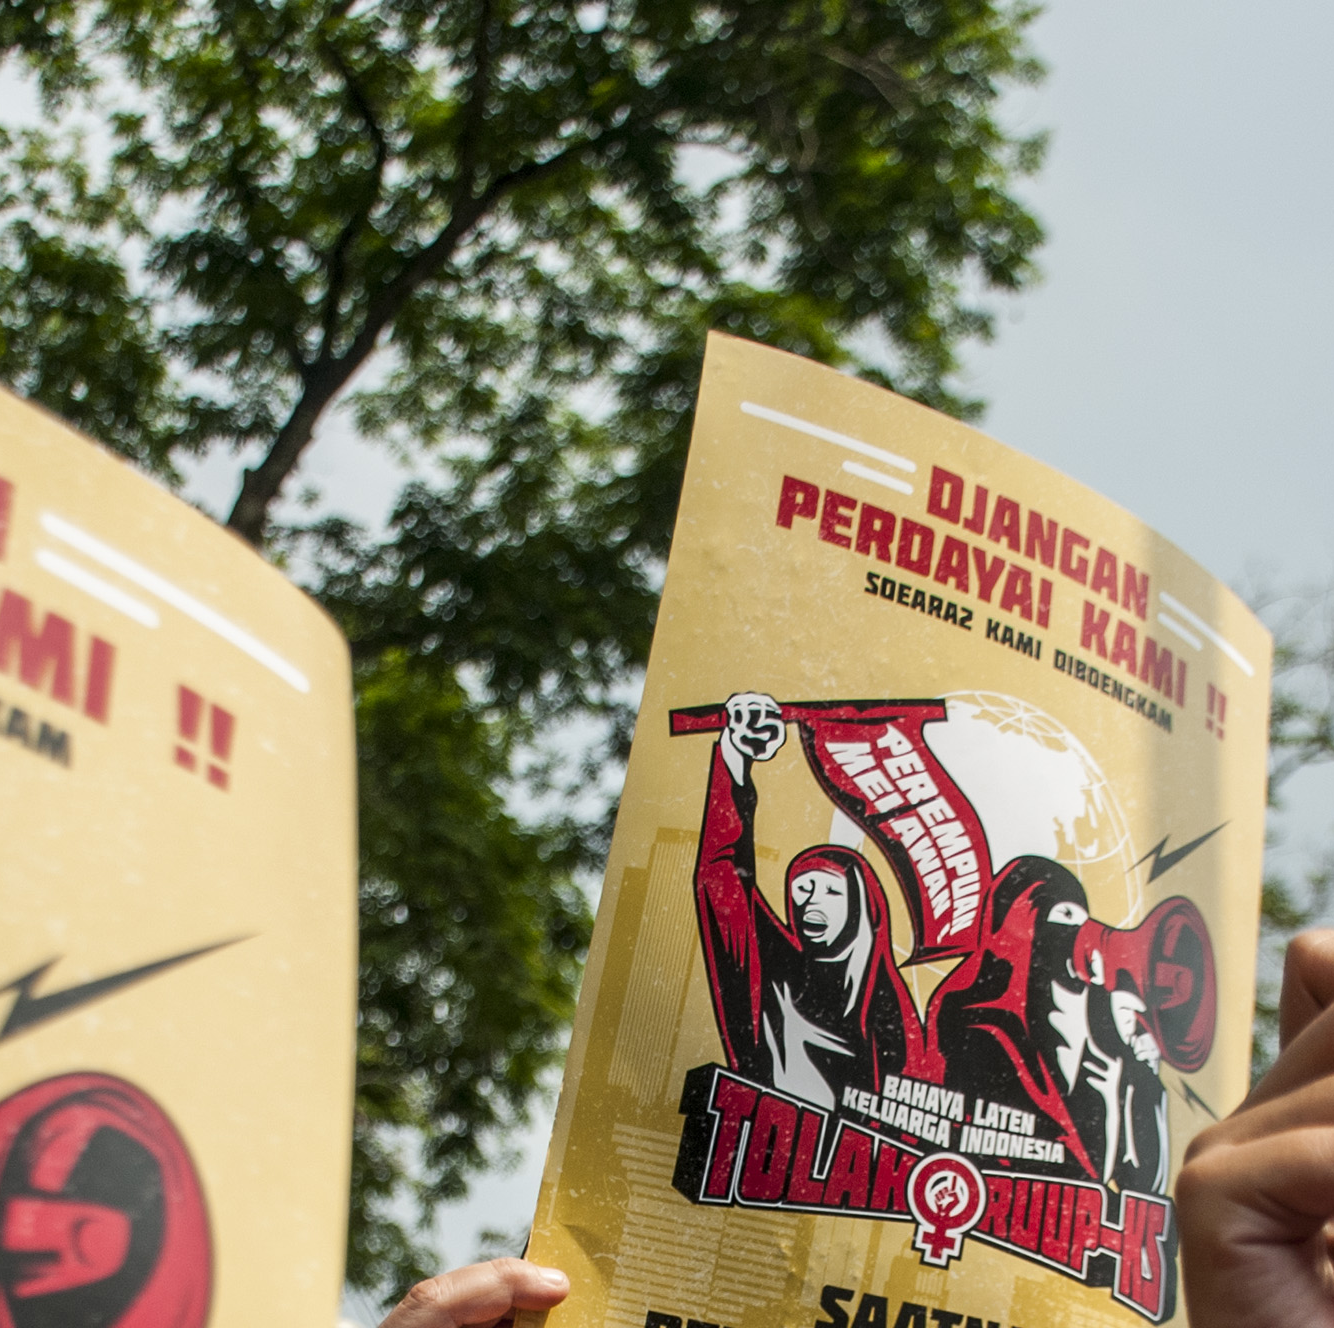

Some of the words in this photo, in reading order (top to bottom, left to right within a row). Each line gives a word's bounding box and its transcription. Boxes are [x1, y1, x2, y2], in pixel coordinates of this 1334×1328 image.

[775, 475, 1053, 630] PERDAYAI
[1079, 601, 1188, 709] KAMI
[925, 465, 1149, 622] DJANGAN
[986, 618, 1043, 661] KAMI
[877, 724, 981, 936] PEREMPUAN
[842, 1086, 952, 1148] KELUARGA
[959, 1125, 1065, 1164] INDONESIA
[882, 1074, 965, 1122] BAHAYA
[973, 1098, 1036, 1136] LATEN
